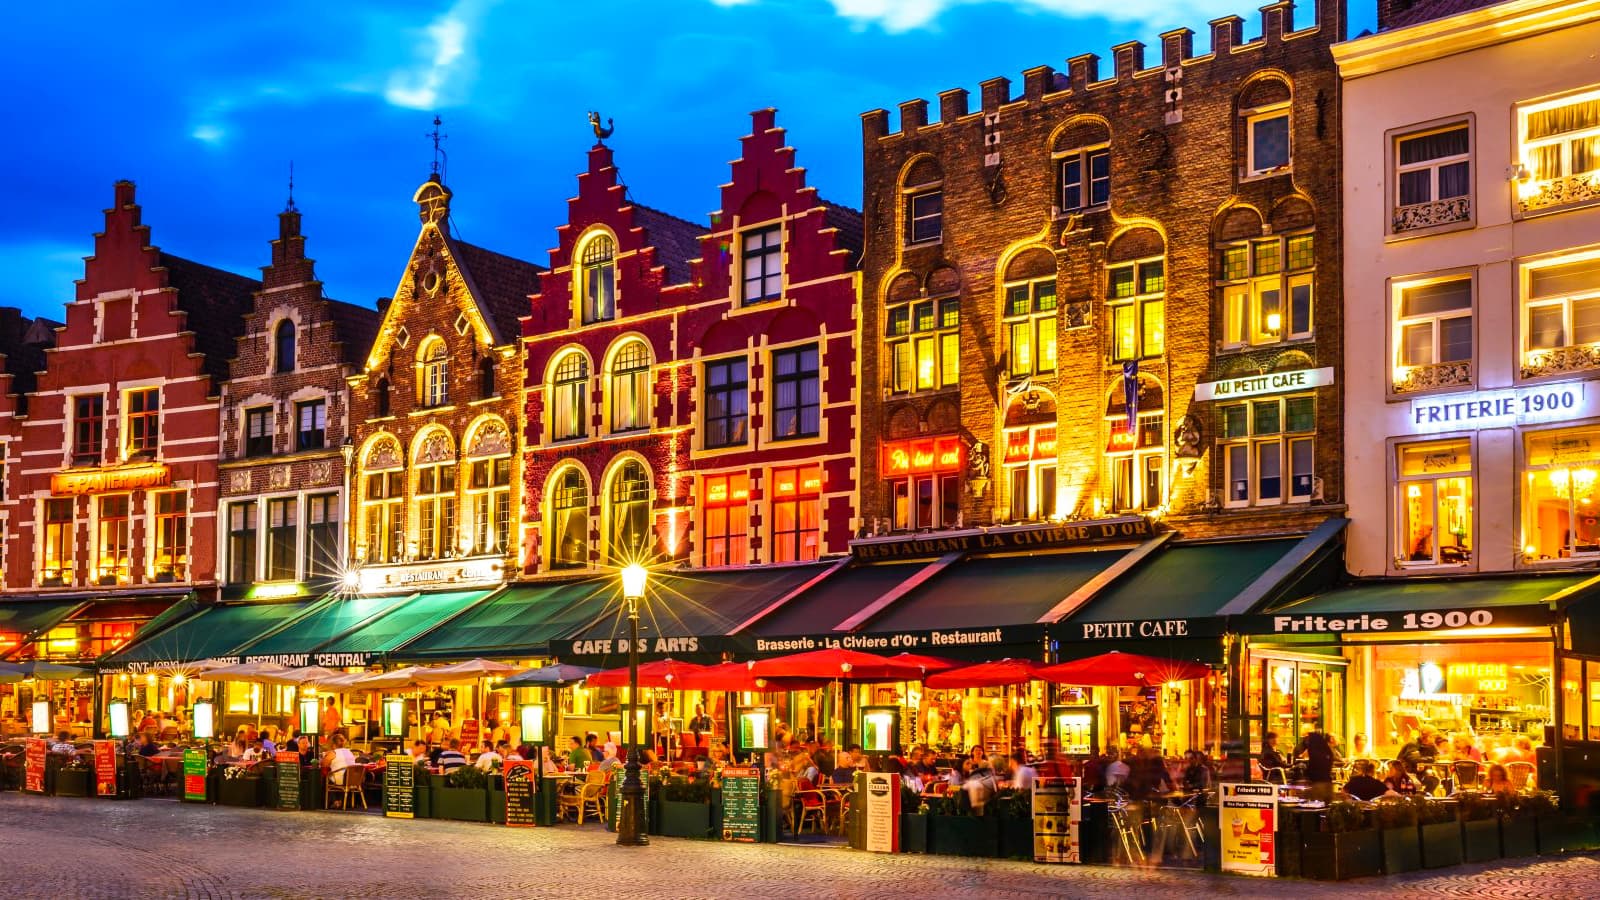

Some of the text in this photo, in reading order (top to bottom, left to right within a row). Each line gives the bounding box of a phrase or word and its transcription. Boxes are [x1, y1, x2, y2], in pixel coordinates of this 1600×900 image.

[1214, 372, 1306, 395] AU PETIT CAFE
[1415, 391, 1574, 424] FRITERIE 1900
[856, 537, 969, 558] RESTAURANT
[979, 535, 1006, 548] LA
[1102, 521, 1147, 537] D'OR
[1083, 620, 1189, 639] PETIT CAFE
[1274, 610, 1493, 632] Friterie 1900
[572, 640, 612, 655] CAFE
[654, 637, 699, 653] ARTS
[757, 628, 1003, 651] Brasserie La Civiere d'Or Restaurant
[128, 661, 150, 674] SINT
[245, 653, 310, 666] RESTAURANT
[314, 652, 371, 666] "CENTRAL"
